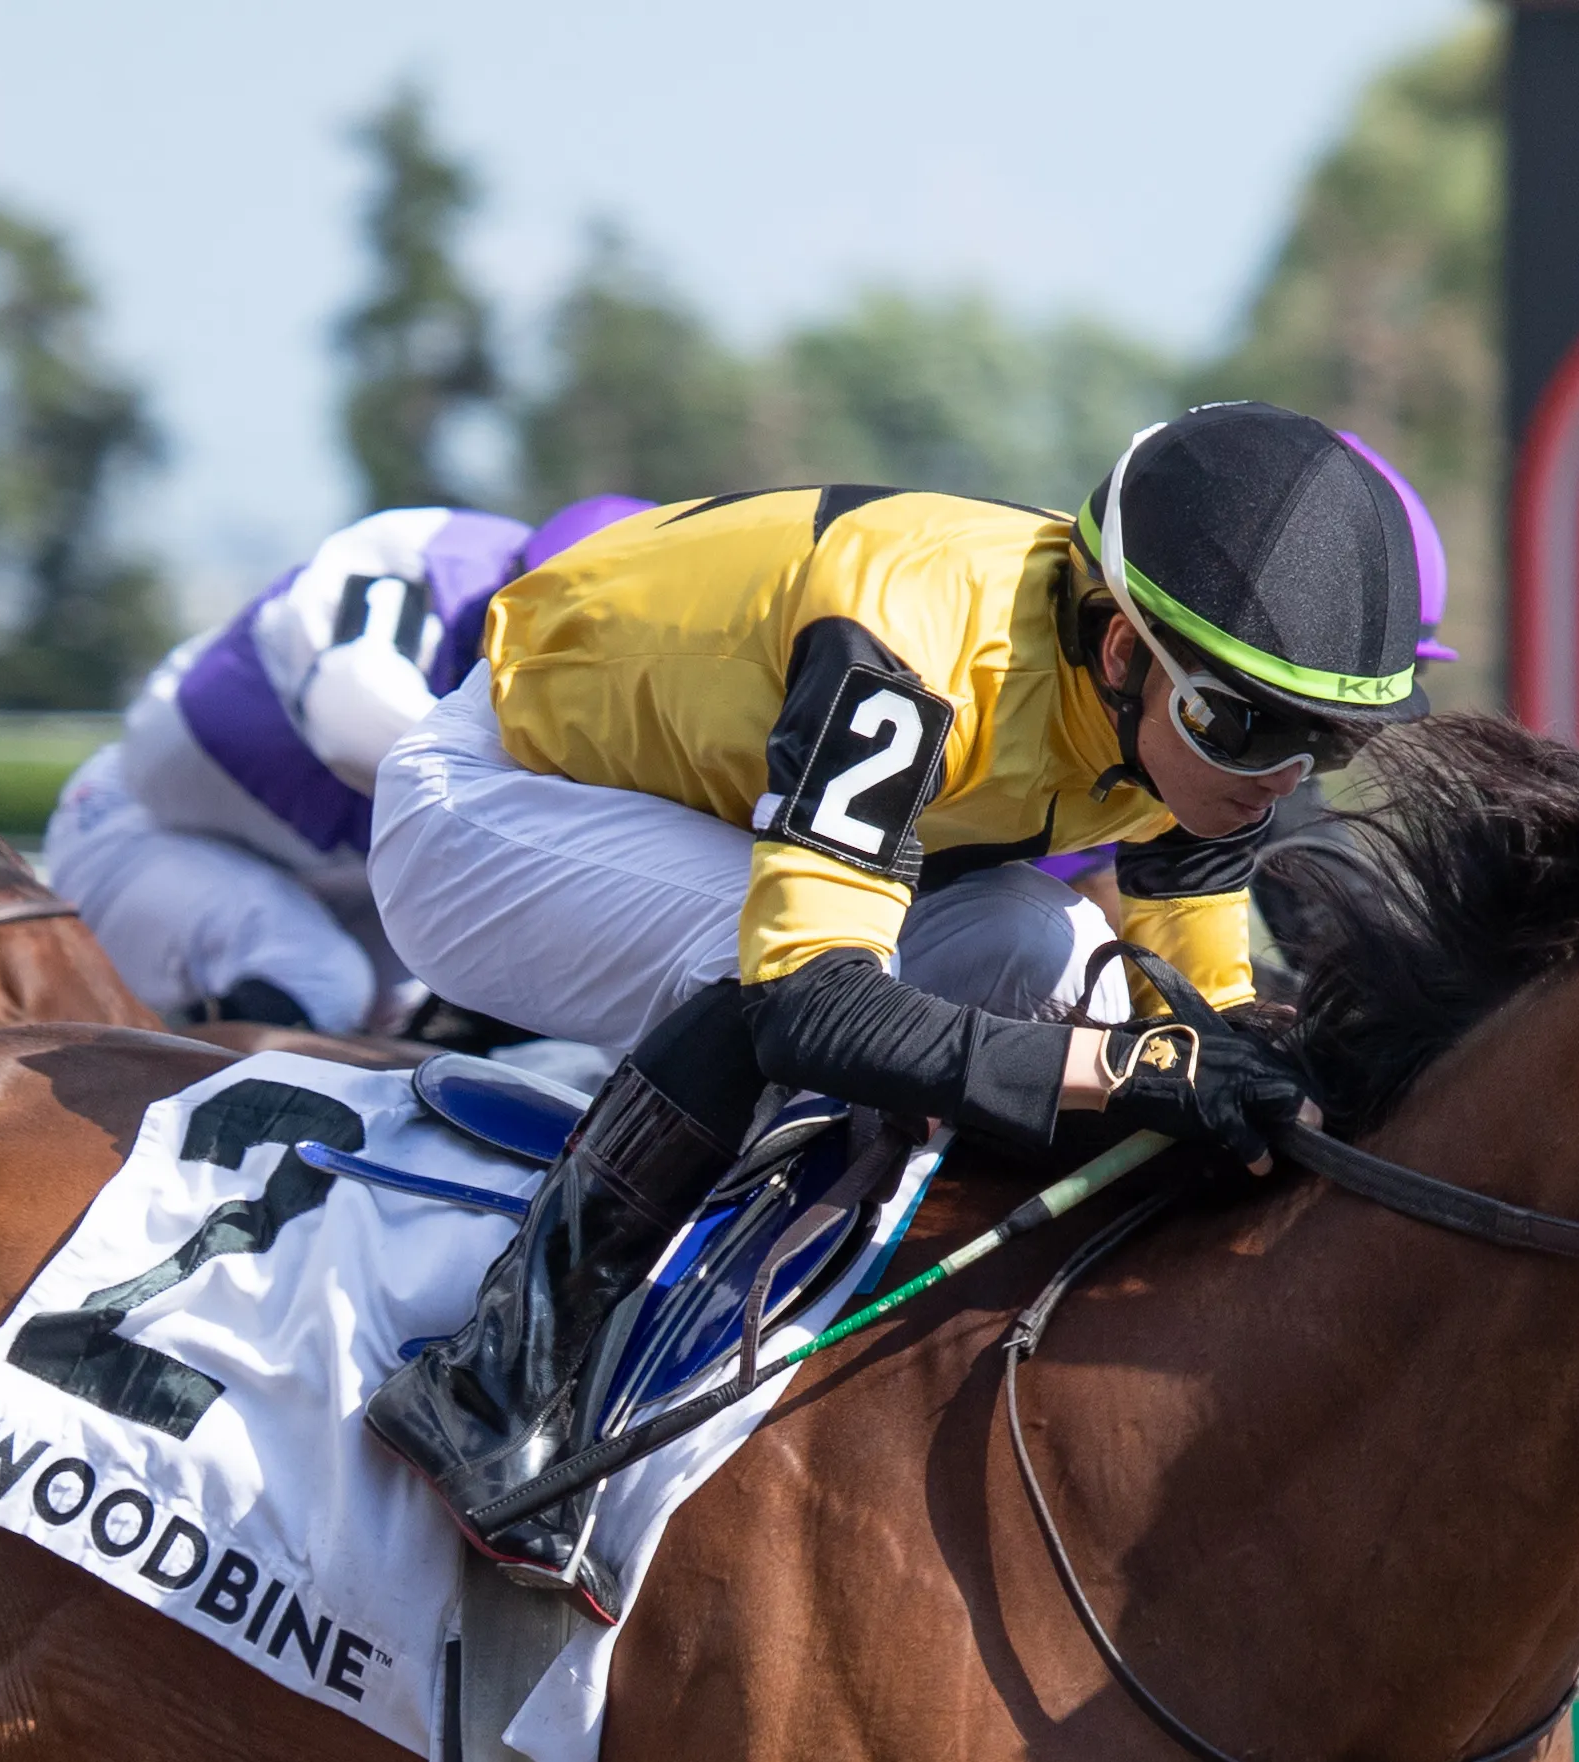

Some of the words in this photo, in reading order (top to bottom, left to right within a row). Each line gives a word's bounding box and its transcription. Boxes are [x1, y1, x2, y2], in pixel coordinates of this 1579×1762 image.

[810, 688, 924, 855] 2
[1337, 676, 1397, 701] KK
[6, 1079, 366, 1441] 2
